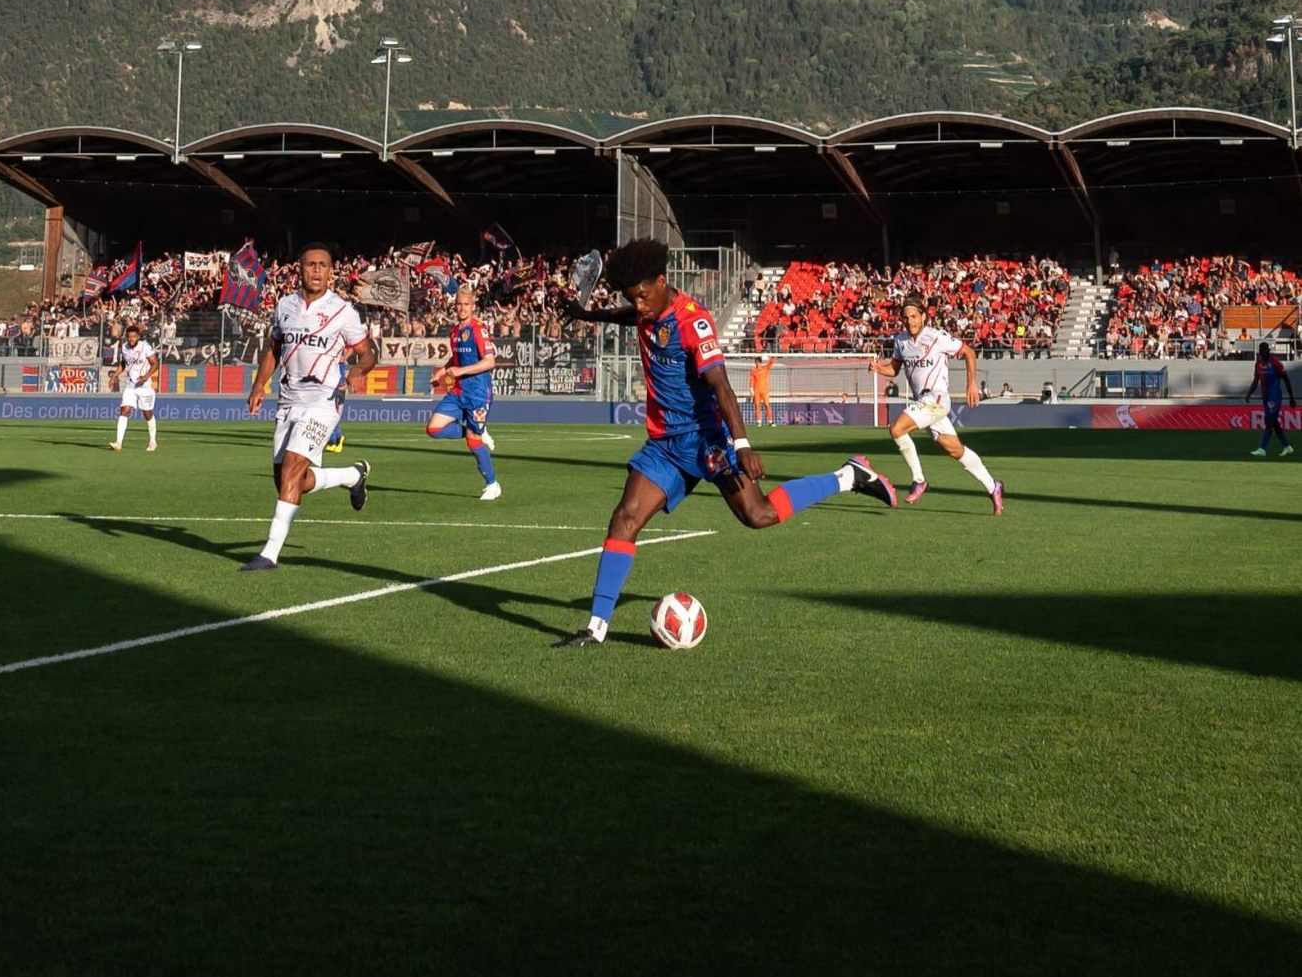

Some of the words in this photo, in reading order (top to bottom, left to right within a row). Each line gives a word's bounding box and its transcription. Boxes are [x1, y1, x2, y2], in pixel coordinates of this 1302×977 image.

[286, 332, 329, 349] OIKEN
[1, 402, 33, 419] Des
[159, 404, 180, 420] de
[185, 404, 220, 420] rêve
[347, 406, 412, 422] banque
